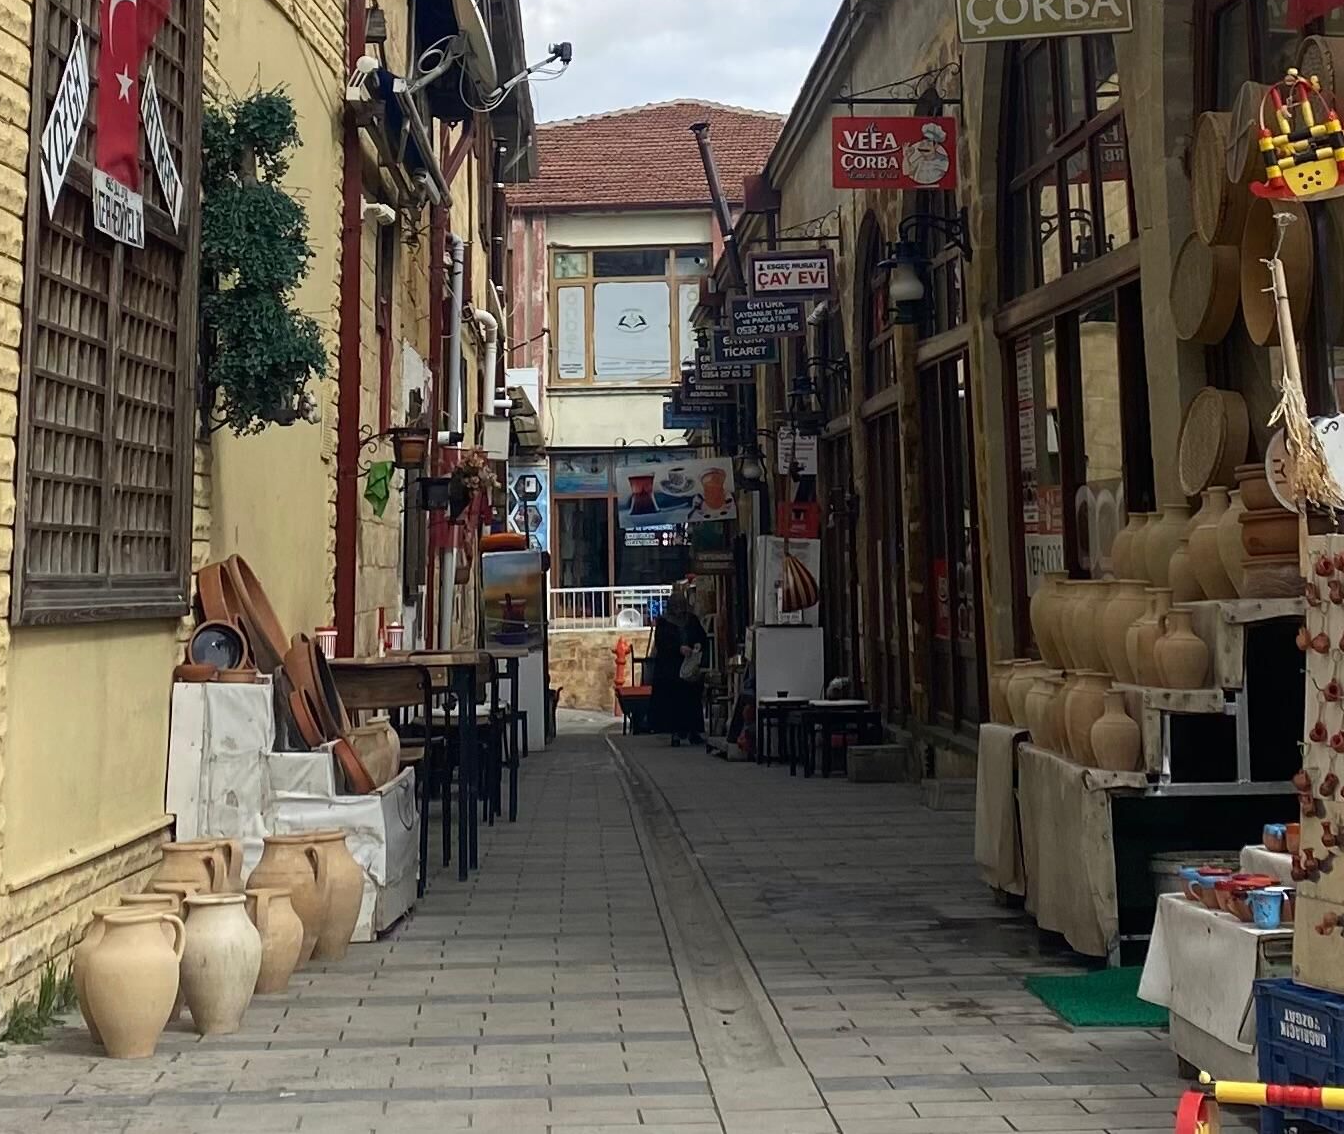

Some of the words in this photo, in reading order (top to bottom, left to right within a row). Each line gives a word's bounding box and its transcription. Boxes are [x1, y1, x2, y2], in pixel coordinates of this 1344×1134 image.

[843, 131, 898, 150] VEFA
[840, 154, 899, 171] ÇORBA
[758, 272, 792, 289] ÇAY
[798, 270, 825, 285] EVİ
[736, 326, 757, 336] 0532
[787, 322, 800, 331] 96
[722, 346, 767, 357] TİCARET
